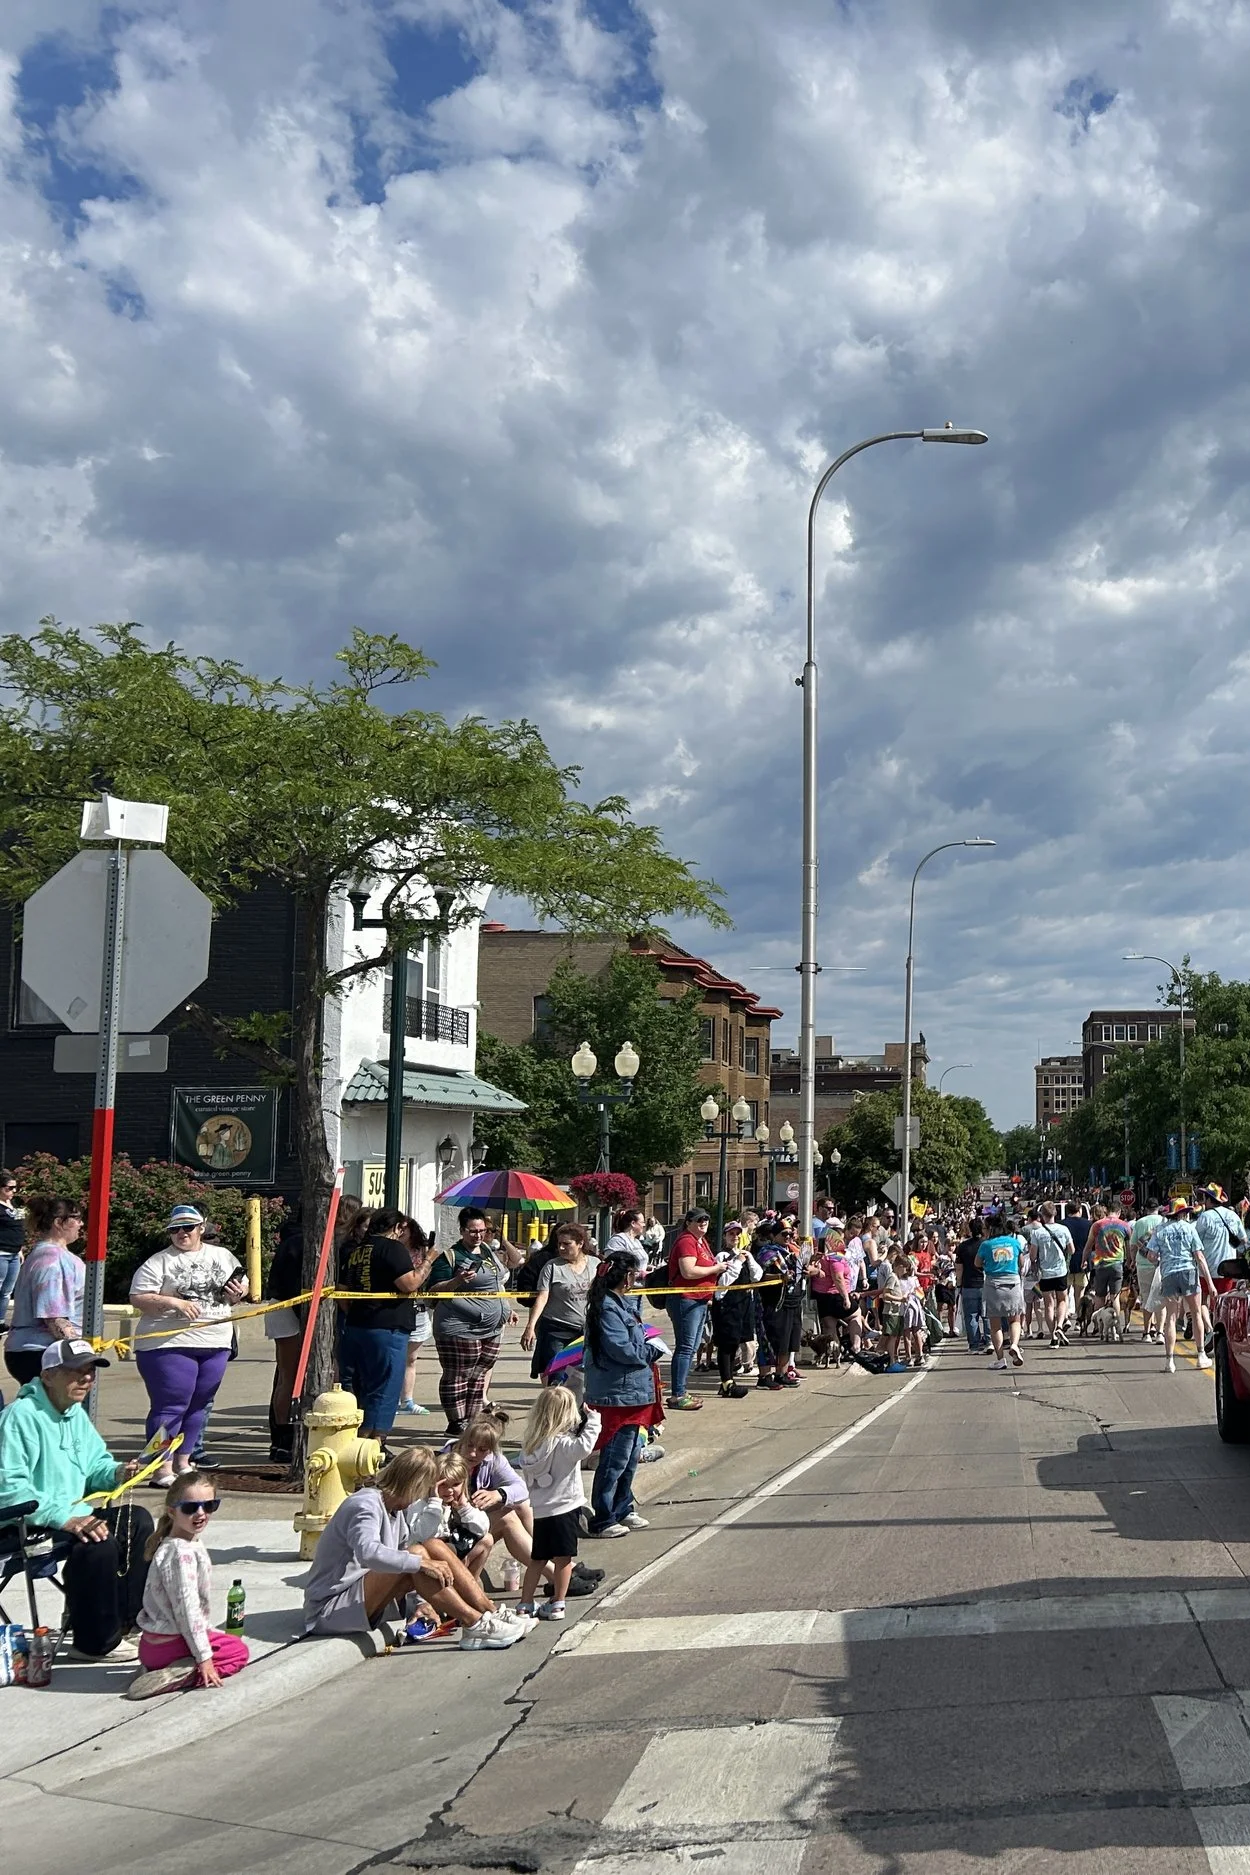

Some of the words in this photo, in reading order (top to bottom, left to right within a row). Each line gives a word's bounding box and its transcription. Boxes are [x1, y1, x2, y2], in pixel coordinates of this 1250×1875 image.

[185, 1095, 201, 1104] THE
[203, 1095, 234, 1103] GREEN
[235, 1094, 267, 1103] PENNY
[219, 1105, 240, 1113] vintage
[369, 1171, 386, 1195] SU
